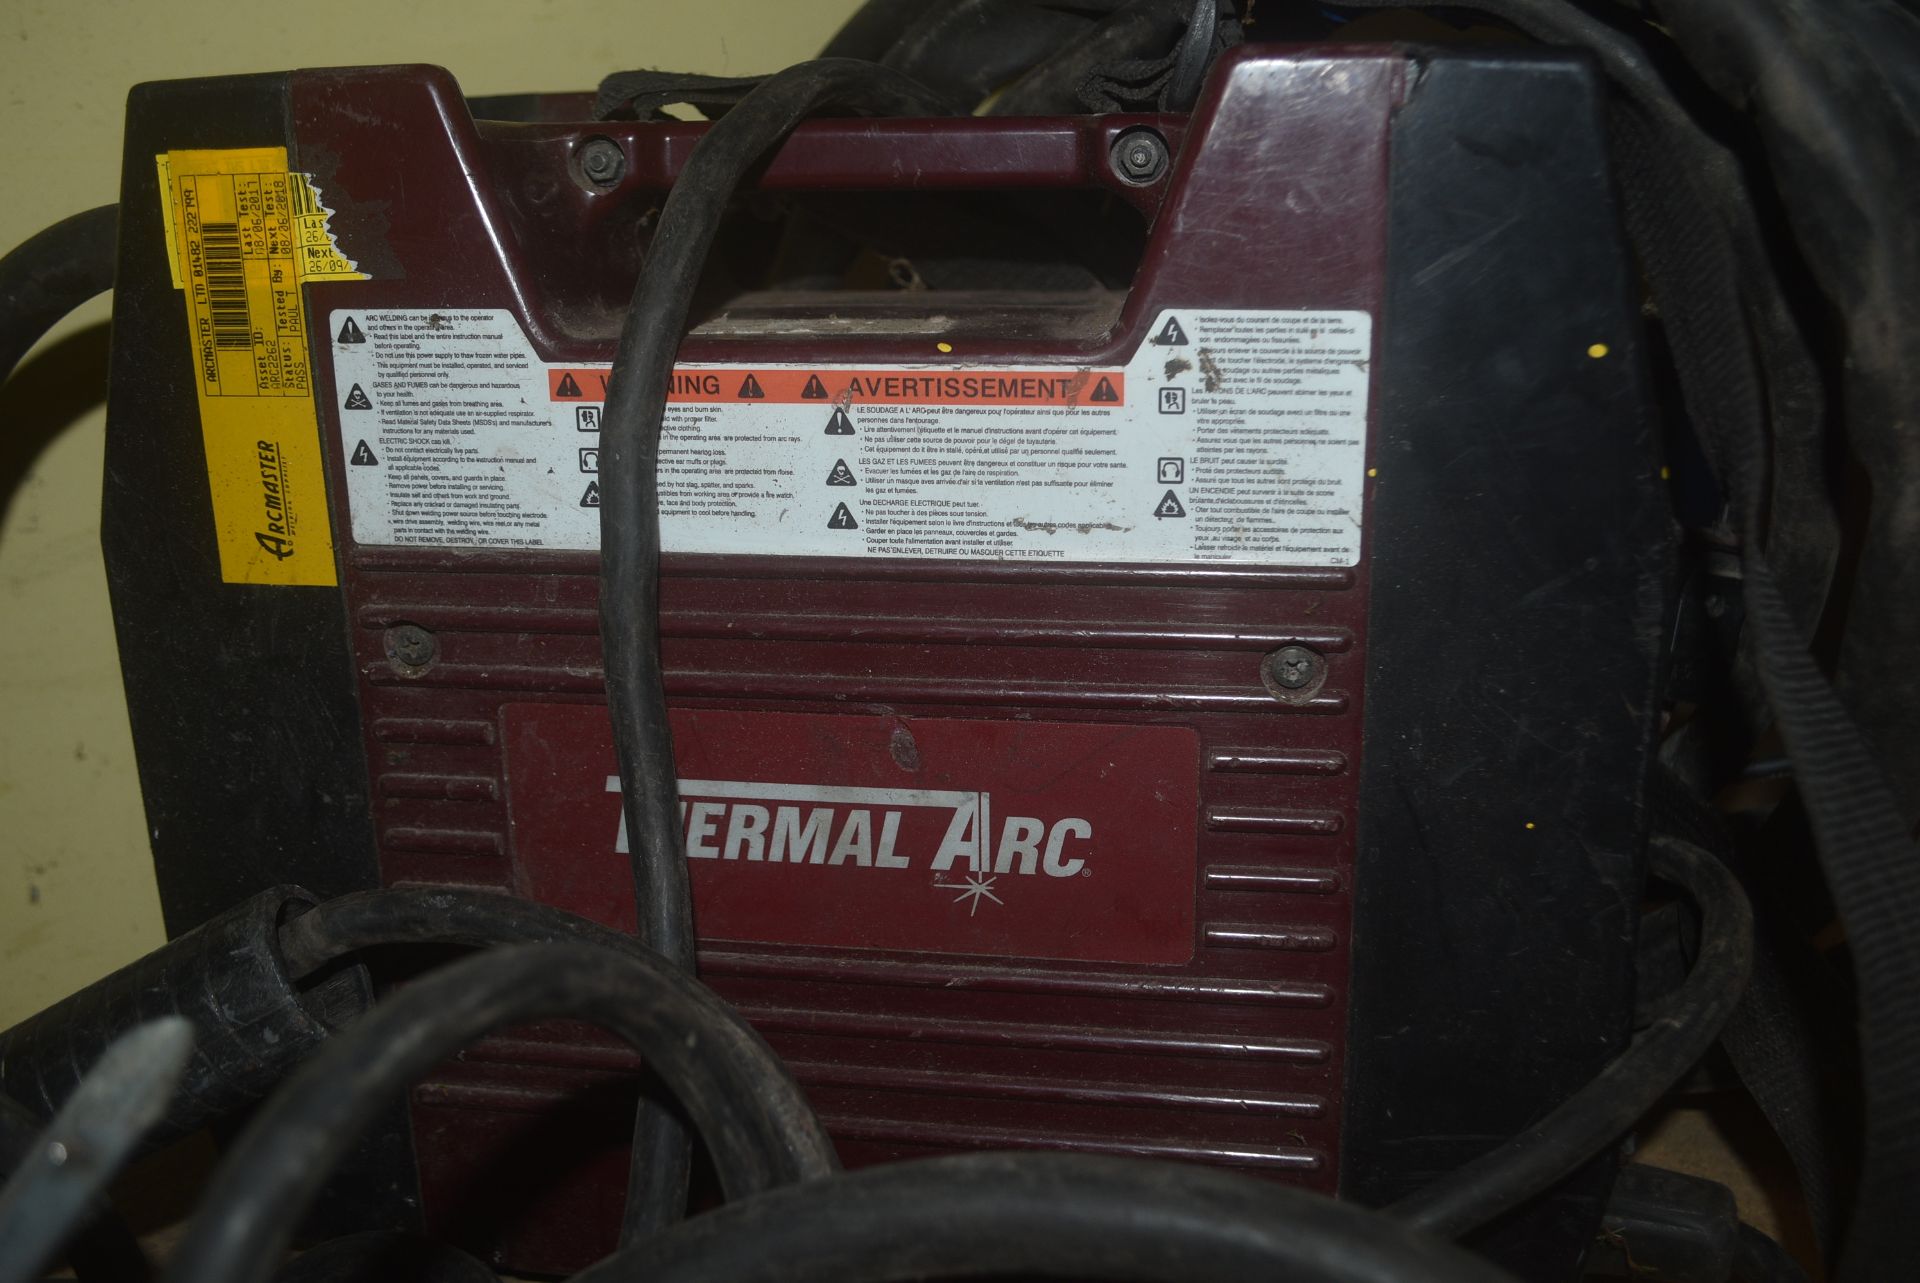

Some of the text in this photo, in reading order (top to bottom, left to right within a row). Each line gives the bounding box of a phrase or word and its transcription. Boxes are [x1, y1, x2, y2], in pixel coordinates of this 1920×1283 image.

[238, 183, 254, 255] Last Test:
[264, 183, 279, 255] Next Test:
[273, 180, 291, 254] 08/06/2018
[304, 218, 325, 229] Las
[190, 241, 204, 277] 01482
[308, 248, 334, 259] Next
[194, 283, 207, 305] LTD
[272, 264, 289, 331] Tested By:
[288, 304, 302, 332] PAUL
[199, 317, 217, 383] ARCMASTER
[252, 328, 271, 390] Asset ID:
[265, 340, 281, 390] ARC2262
[282, 341, 296, 389] Status:
[293, 361, 307, 390] PASS
[850, 376, 1072, 399] AVERTISSEMENT
[255, 440, 295, 561] ARCMASTER
[924, 547, 957, 555] DETRUIRE
[970, 547, 1003, 556] MASQUER
[1004, 548, 1026, 556] CETTE
[1027, 548, 1064, 557] ETIQUETTE
[605, 775, 1093, 878] TERMAL ARC
